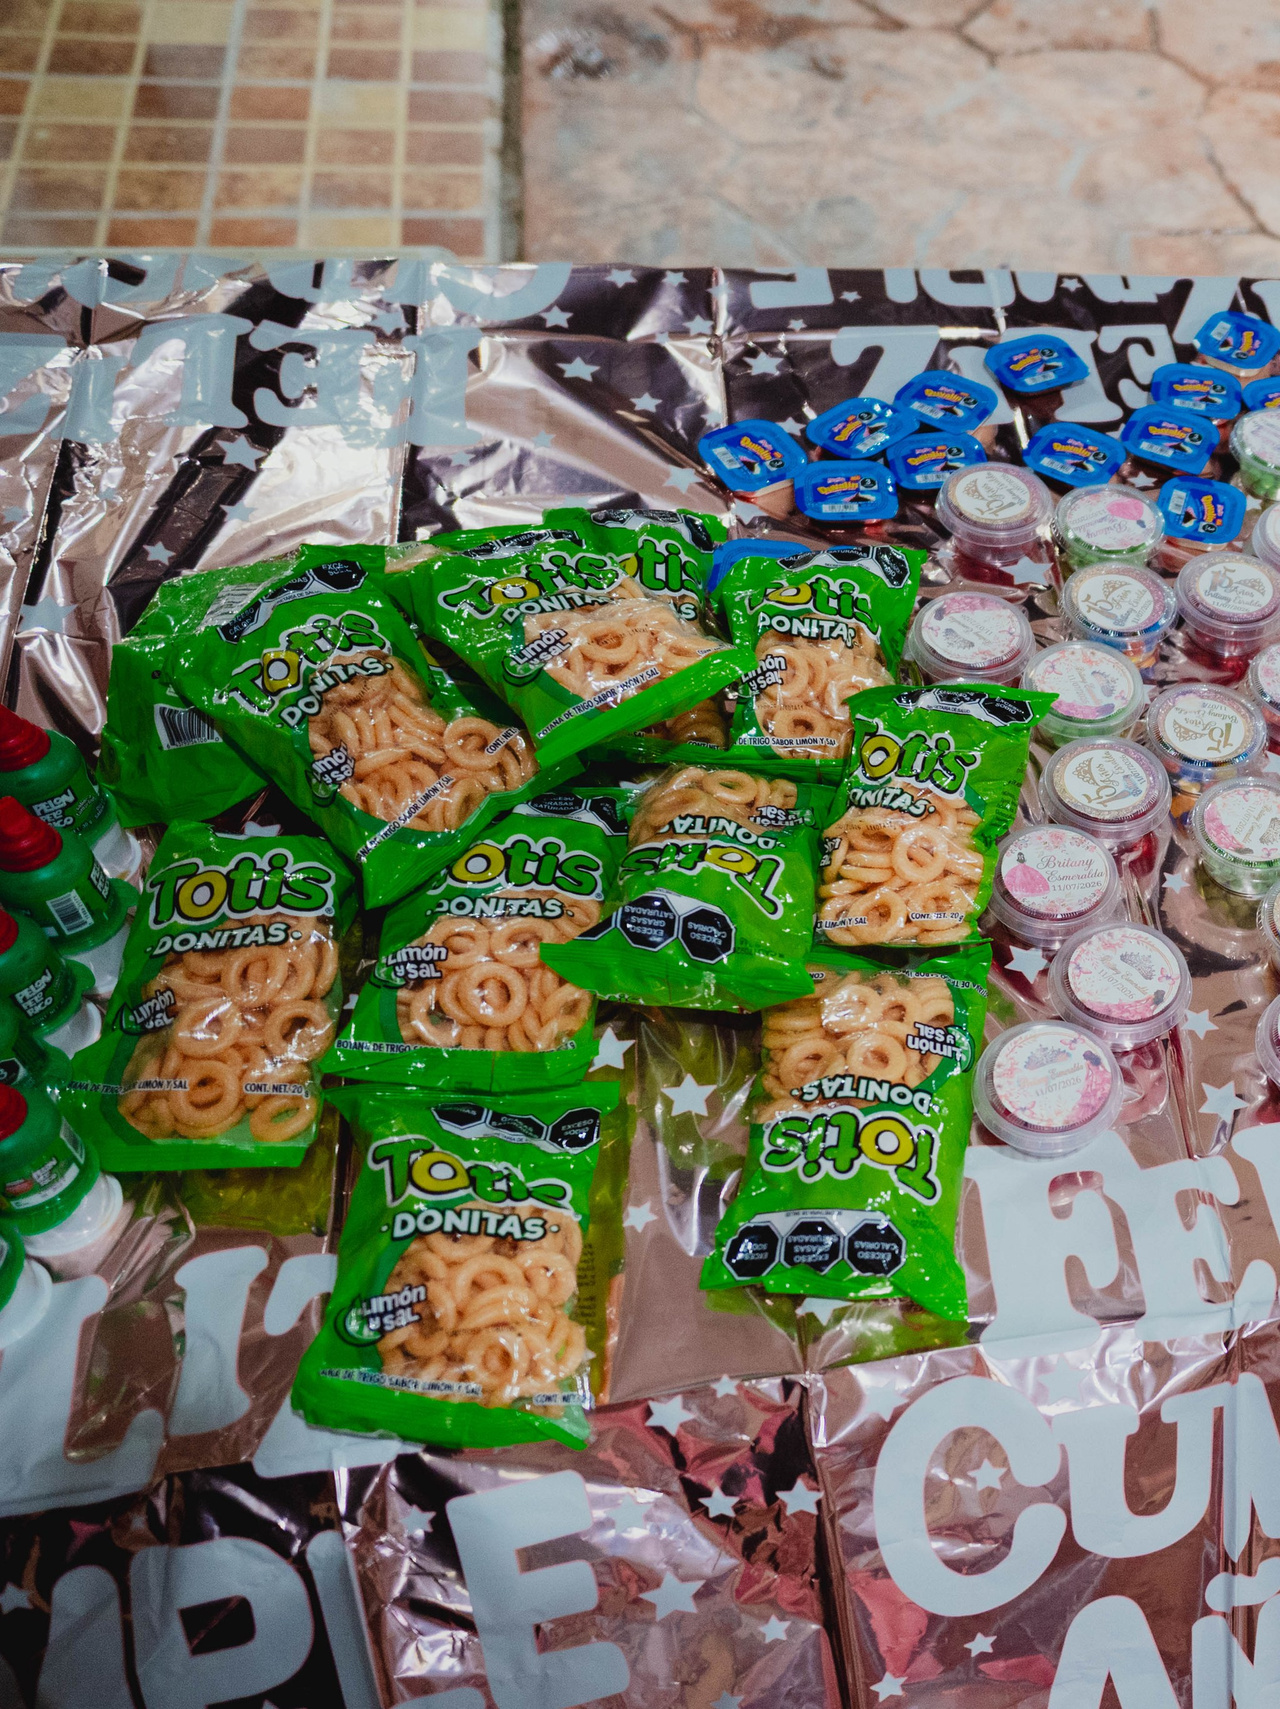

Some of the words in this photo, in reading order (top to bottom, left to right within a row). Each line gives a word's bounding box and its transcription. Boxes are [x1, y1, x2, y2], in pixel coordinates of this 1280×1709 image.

[437, 553, 626, 619] Totis
[502, 592, 612, 626] DONITA
[735, 574, 881, 645] Totis
[515, 628, 567, 665] Limón
[212, 610, 393, 717] Totis
[279, 657, 389, 729] DONITAS
[563, 709, 575, 721] DE
[572, 700, 595, 715] TRIGO
[593, 688, 617, 706] SABOR
[644, 667, 660, 682] SAL
[738, 737, 749, 746] DE
[749, 737, 771, 746] TRIGO
[771, 737, 795, 746] SABOR
[795, 735, 818, 746] LIMÓN
[1207, 723, 1234, 753] 15
[850, 714, 981, 799] Totis
[850, 788, 929, 813] ONITAS
[448, 834, 604, 900] otis
[1036, 855, 1095, 872] Britany
[1046, 869, 1105, 882] Esmeralda
[146, 848, 336, 930] Totis
[1051, 881, 1103, 892] 11/07/2026
[624, 904, 675, 919] SATURADAS
[630, 915, 666, 928] GRASAS
[854, 916, 867, 925] SAL
[150, 923, 288, 957] DONITAS
[628, 925, 664, 937] EXCESO
[690, 931, 724, 946] EXCESO
[386, 943, 447, 968] Limón
[1099, 969, 1135, 1000] 11/07/2026
[371, 1043, 382, 1052] DE
[906, 1033, 966, 1066] Limón
[137, 1078, 164, 1089] LIMÓN
[173, 1080, 188, 1090] SAL
[244, 1083, 270, 1093] CONT.
[802, 1074, 934, 1116] DONITAS
[1035, 1077, 1082, 1097] 11/07/2026
[760, 1105, 943, 1207] Totis
[391, 1209, 547, 1242] DONITAS
[857, 1250, 892, 1261] EXCESO
[362, 1283, 427, 1314] Limón
